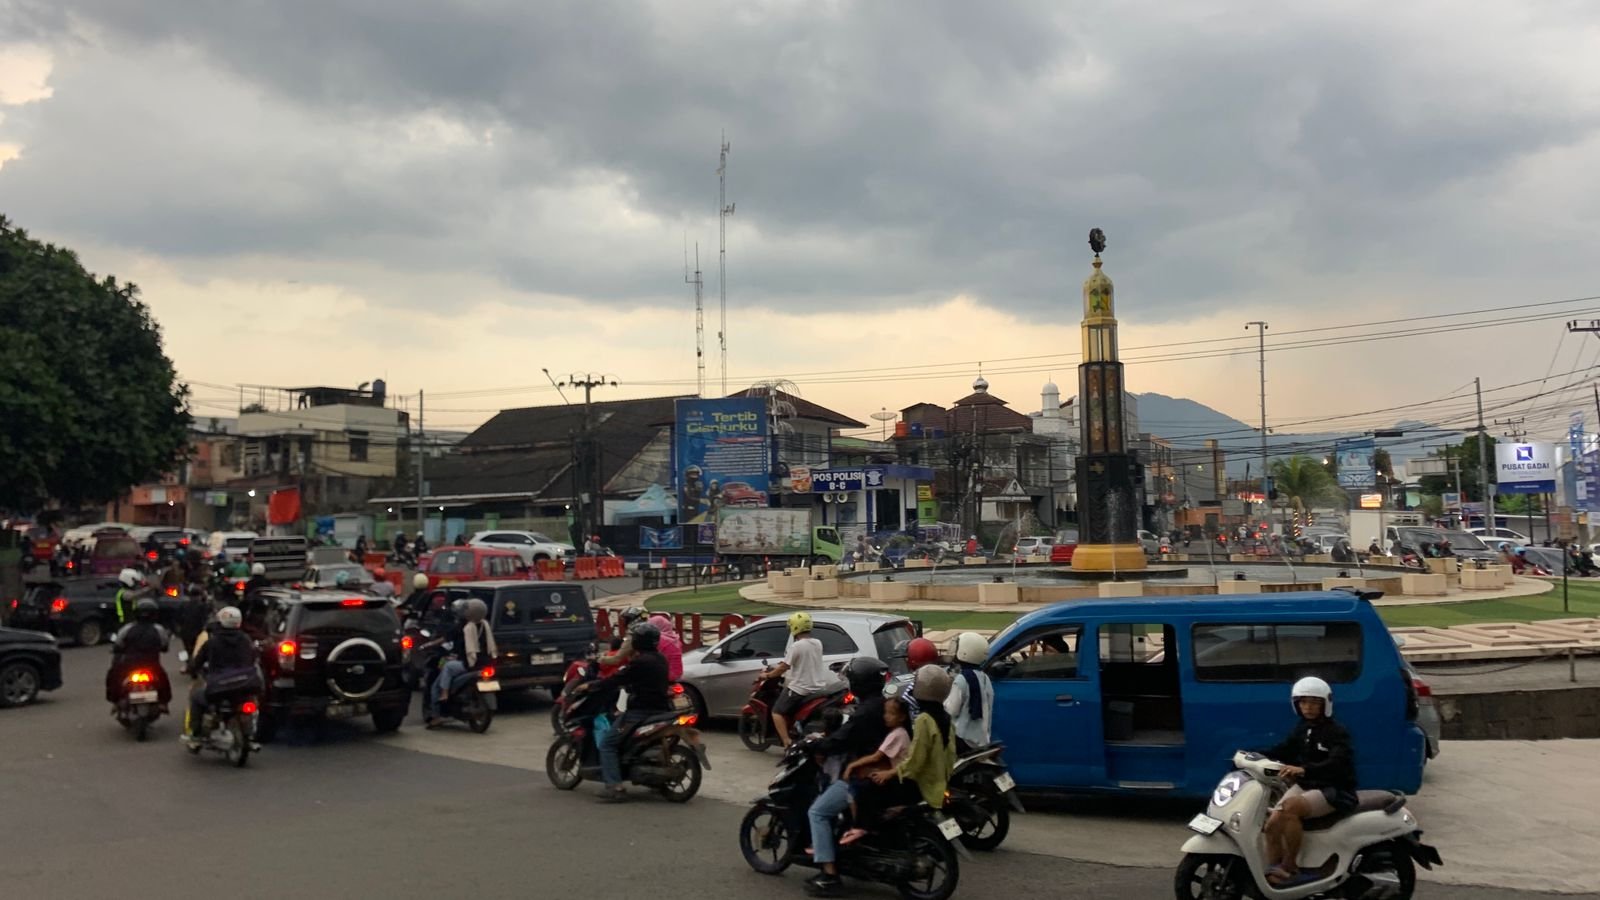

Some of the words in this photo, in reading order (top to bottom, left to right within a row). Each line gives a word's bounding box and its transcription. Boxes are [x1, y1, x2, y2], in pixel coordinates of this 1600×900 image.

[711, 411, 757, 422] Tertib
[687, 422, 758, 434] Cianjurku
[813, 473, 832, 482] POS
[833, 472, 862, 481] POLISI
